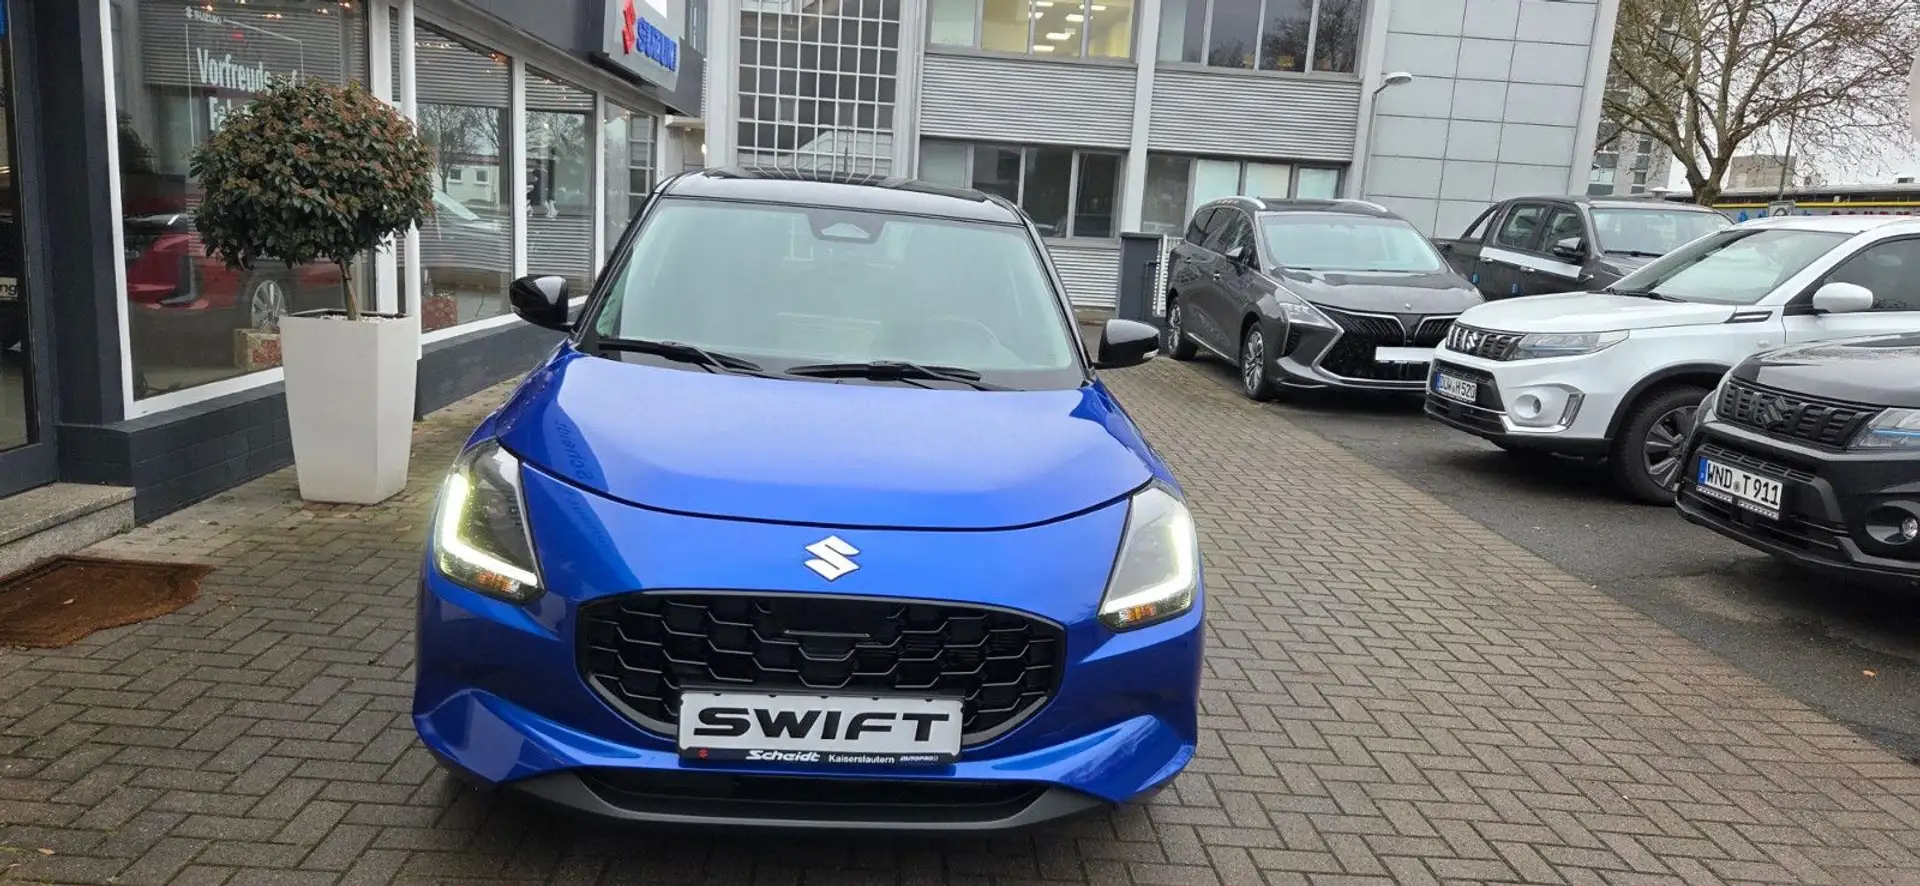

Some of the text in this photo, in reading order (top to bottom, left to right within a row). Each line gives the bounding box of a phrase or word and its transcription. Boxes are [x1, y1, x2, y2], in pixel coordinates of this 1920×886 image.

[636, 16, 677, 72] SUZUKI
[693, 707, 950, 742] SWIFT
[746, 749, 821, 763] Scheidt
[828, 753, 895, 764] Kaiserslautern
